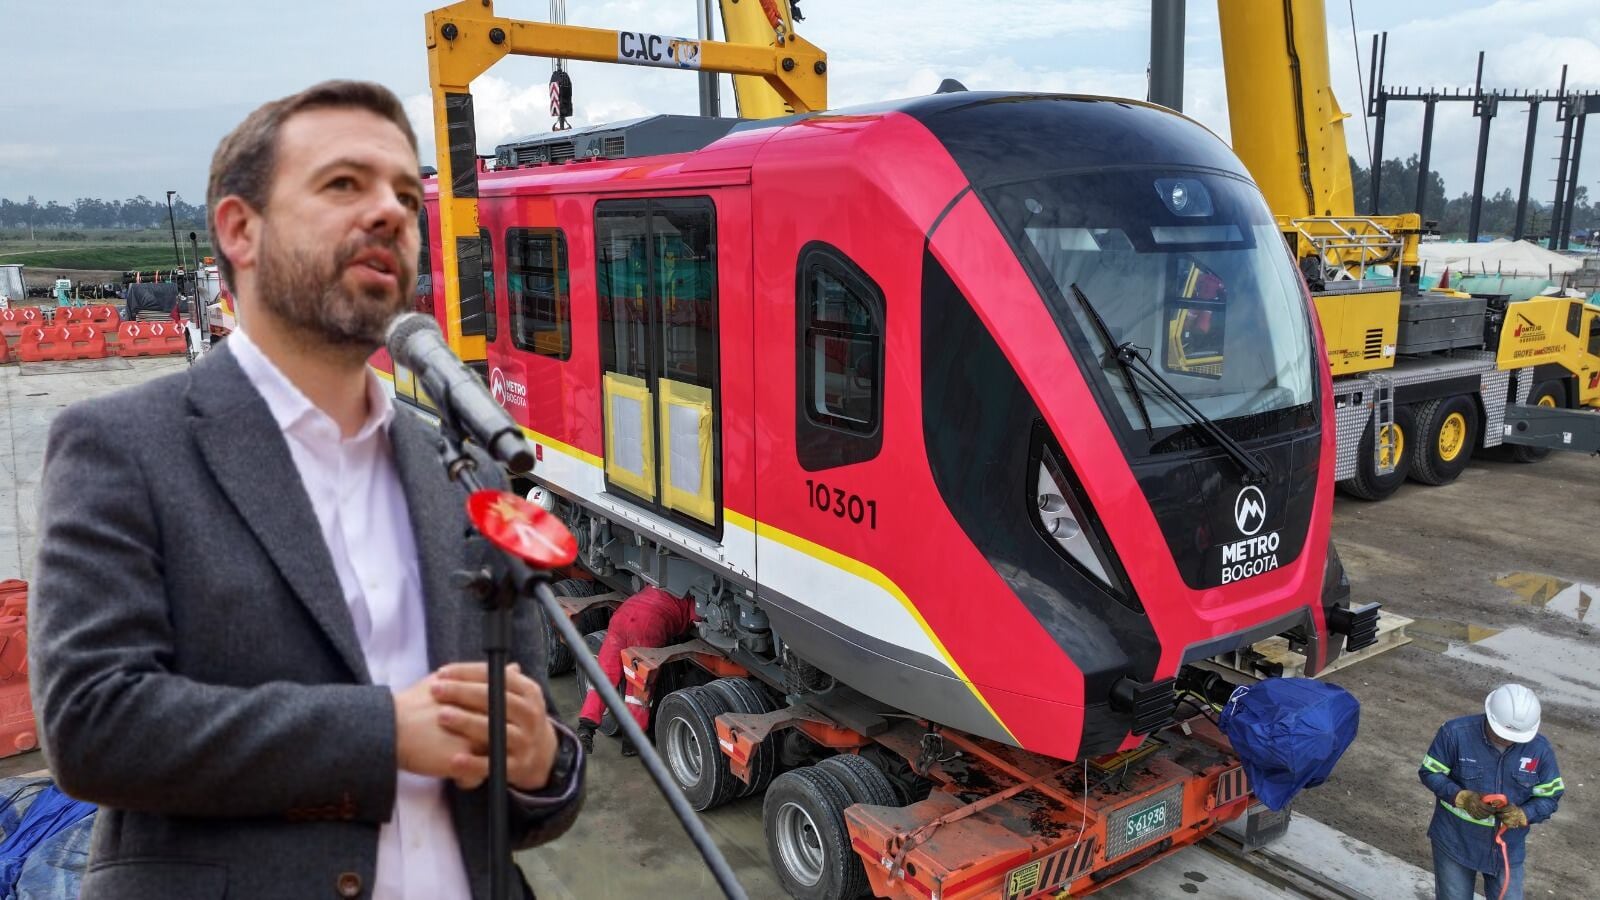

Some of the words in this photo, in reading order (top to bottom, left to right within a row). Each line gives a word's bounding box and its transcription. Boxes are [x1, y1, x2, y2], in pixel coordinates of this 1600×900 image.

[620, 31, 662, 62] CAC
[506, 380, 526, 397] METRO
[506, 393, 527, 407] BOGOTA
[806, 479, 876, 530] 10301
[1222, 532, 1280, 565] METRO
[1221, 554, 1279, 585] BOGOTA
